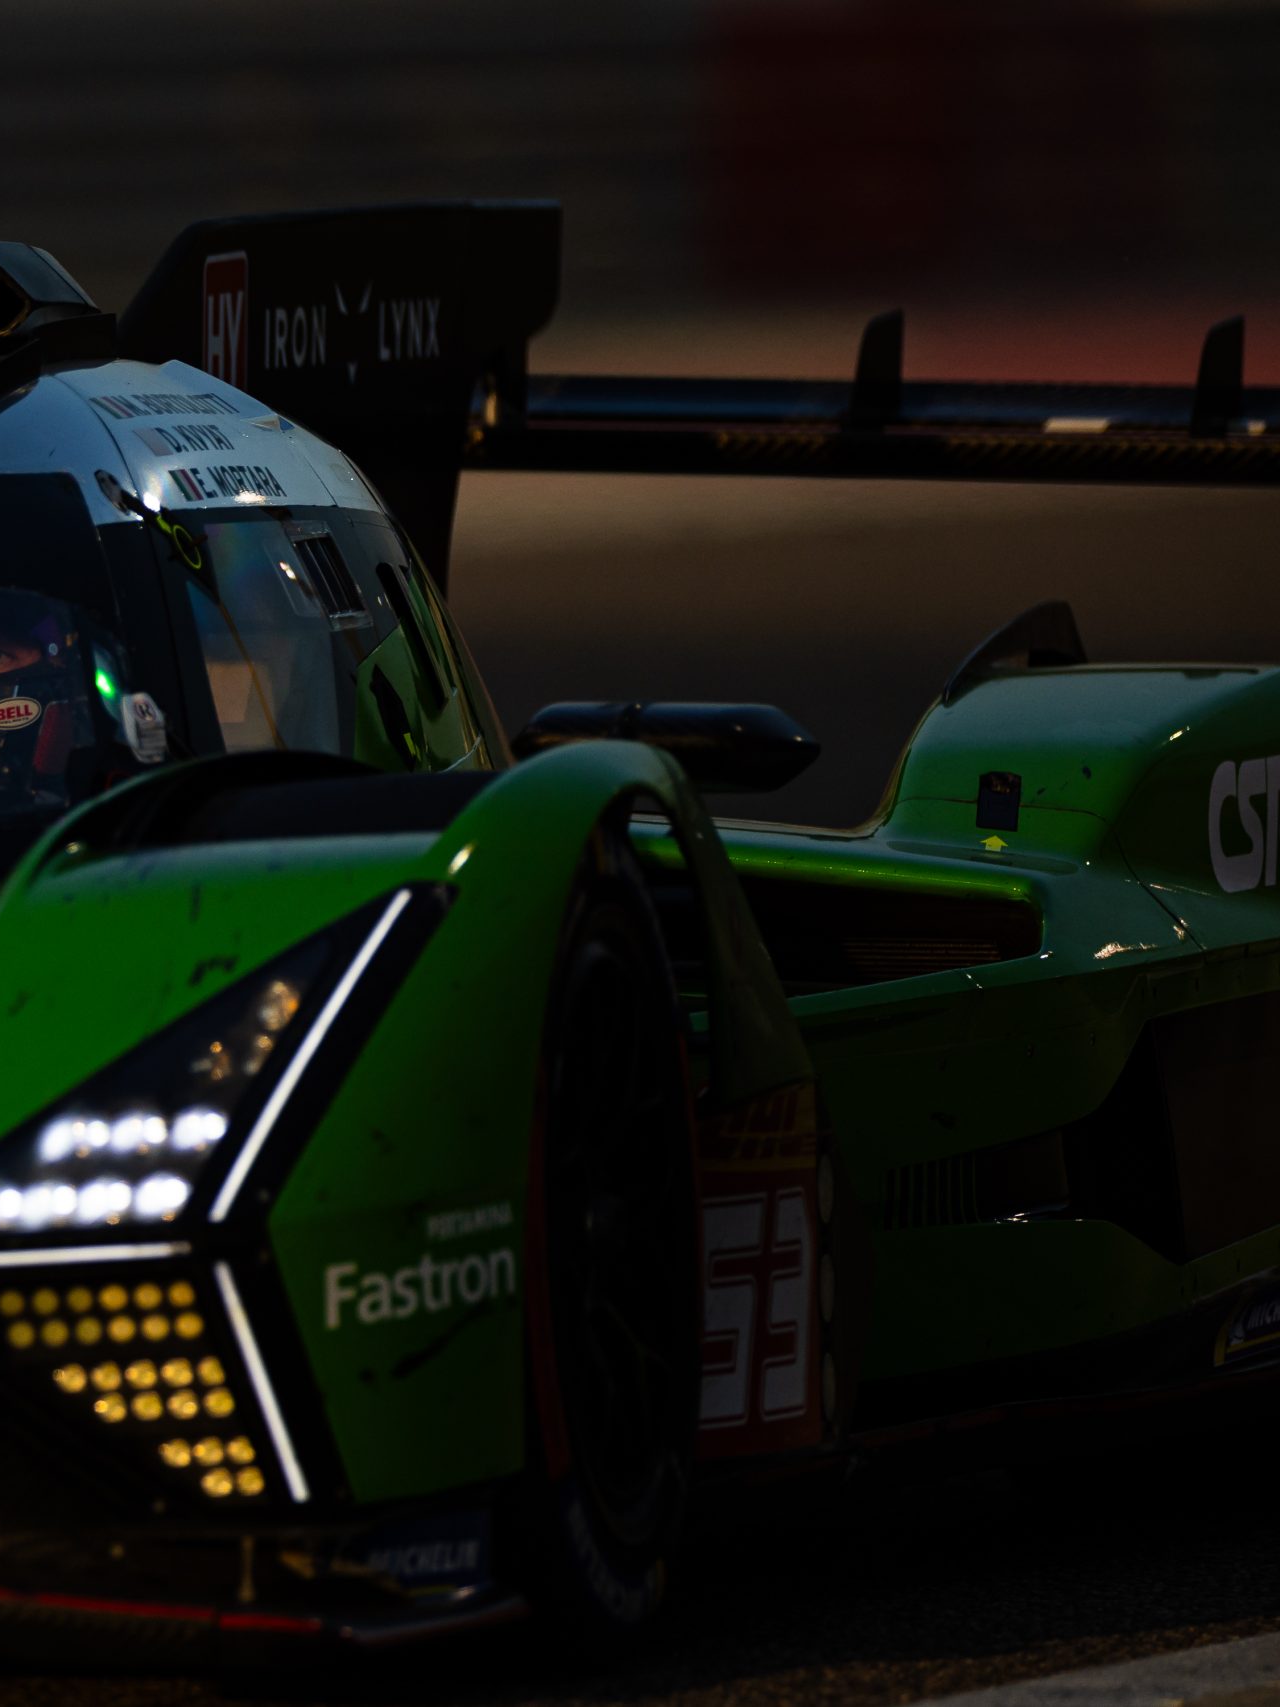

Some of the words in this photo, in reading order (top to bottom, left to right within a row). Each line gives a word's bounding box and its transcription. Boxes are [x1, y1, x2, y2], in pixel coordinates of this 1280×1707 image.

[206, 288, 245, 387] HY
[264, 302, 328, 370] IRON
[376, 296, 442, 363] LYNX
[171, 424, 235, 452] KVYAT
[190, 468, 218, 499] E.
[206, 465, 288, 498] MORTARA
[322, 1245, 517, 1331] Fastron
